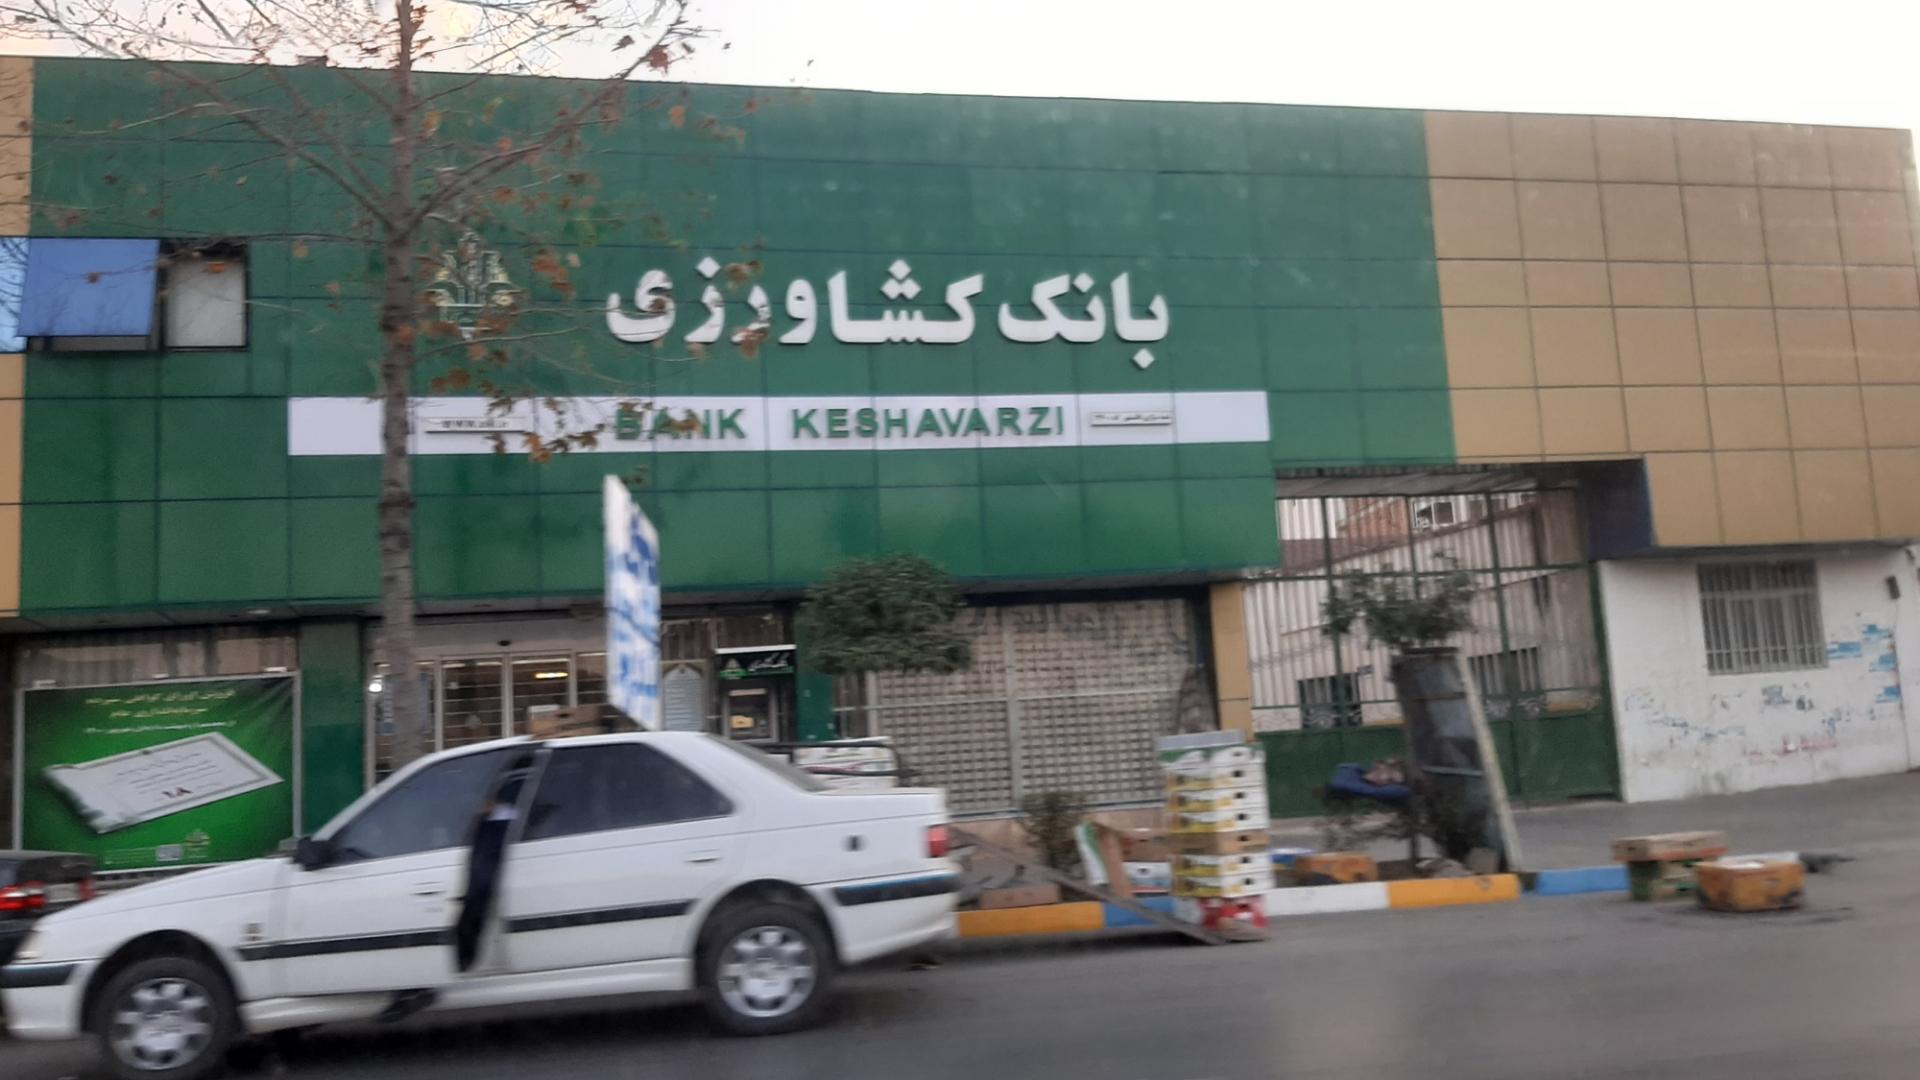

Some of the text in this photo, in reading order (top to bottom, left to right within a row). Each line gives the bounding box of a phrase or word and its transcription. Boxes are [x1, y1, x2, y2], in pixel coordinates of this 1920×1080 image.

[606, 257, 1170, 370] بانک کشاورزی
[792, 406, 1065, 439] KESHAVARZI
